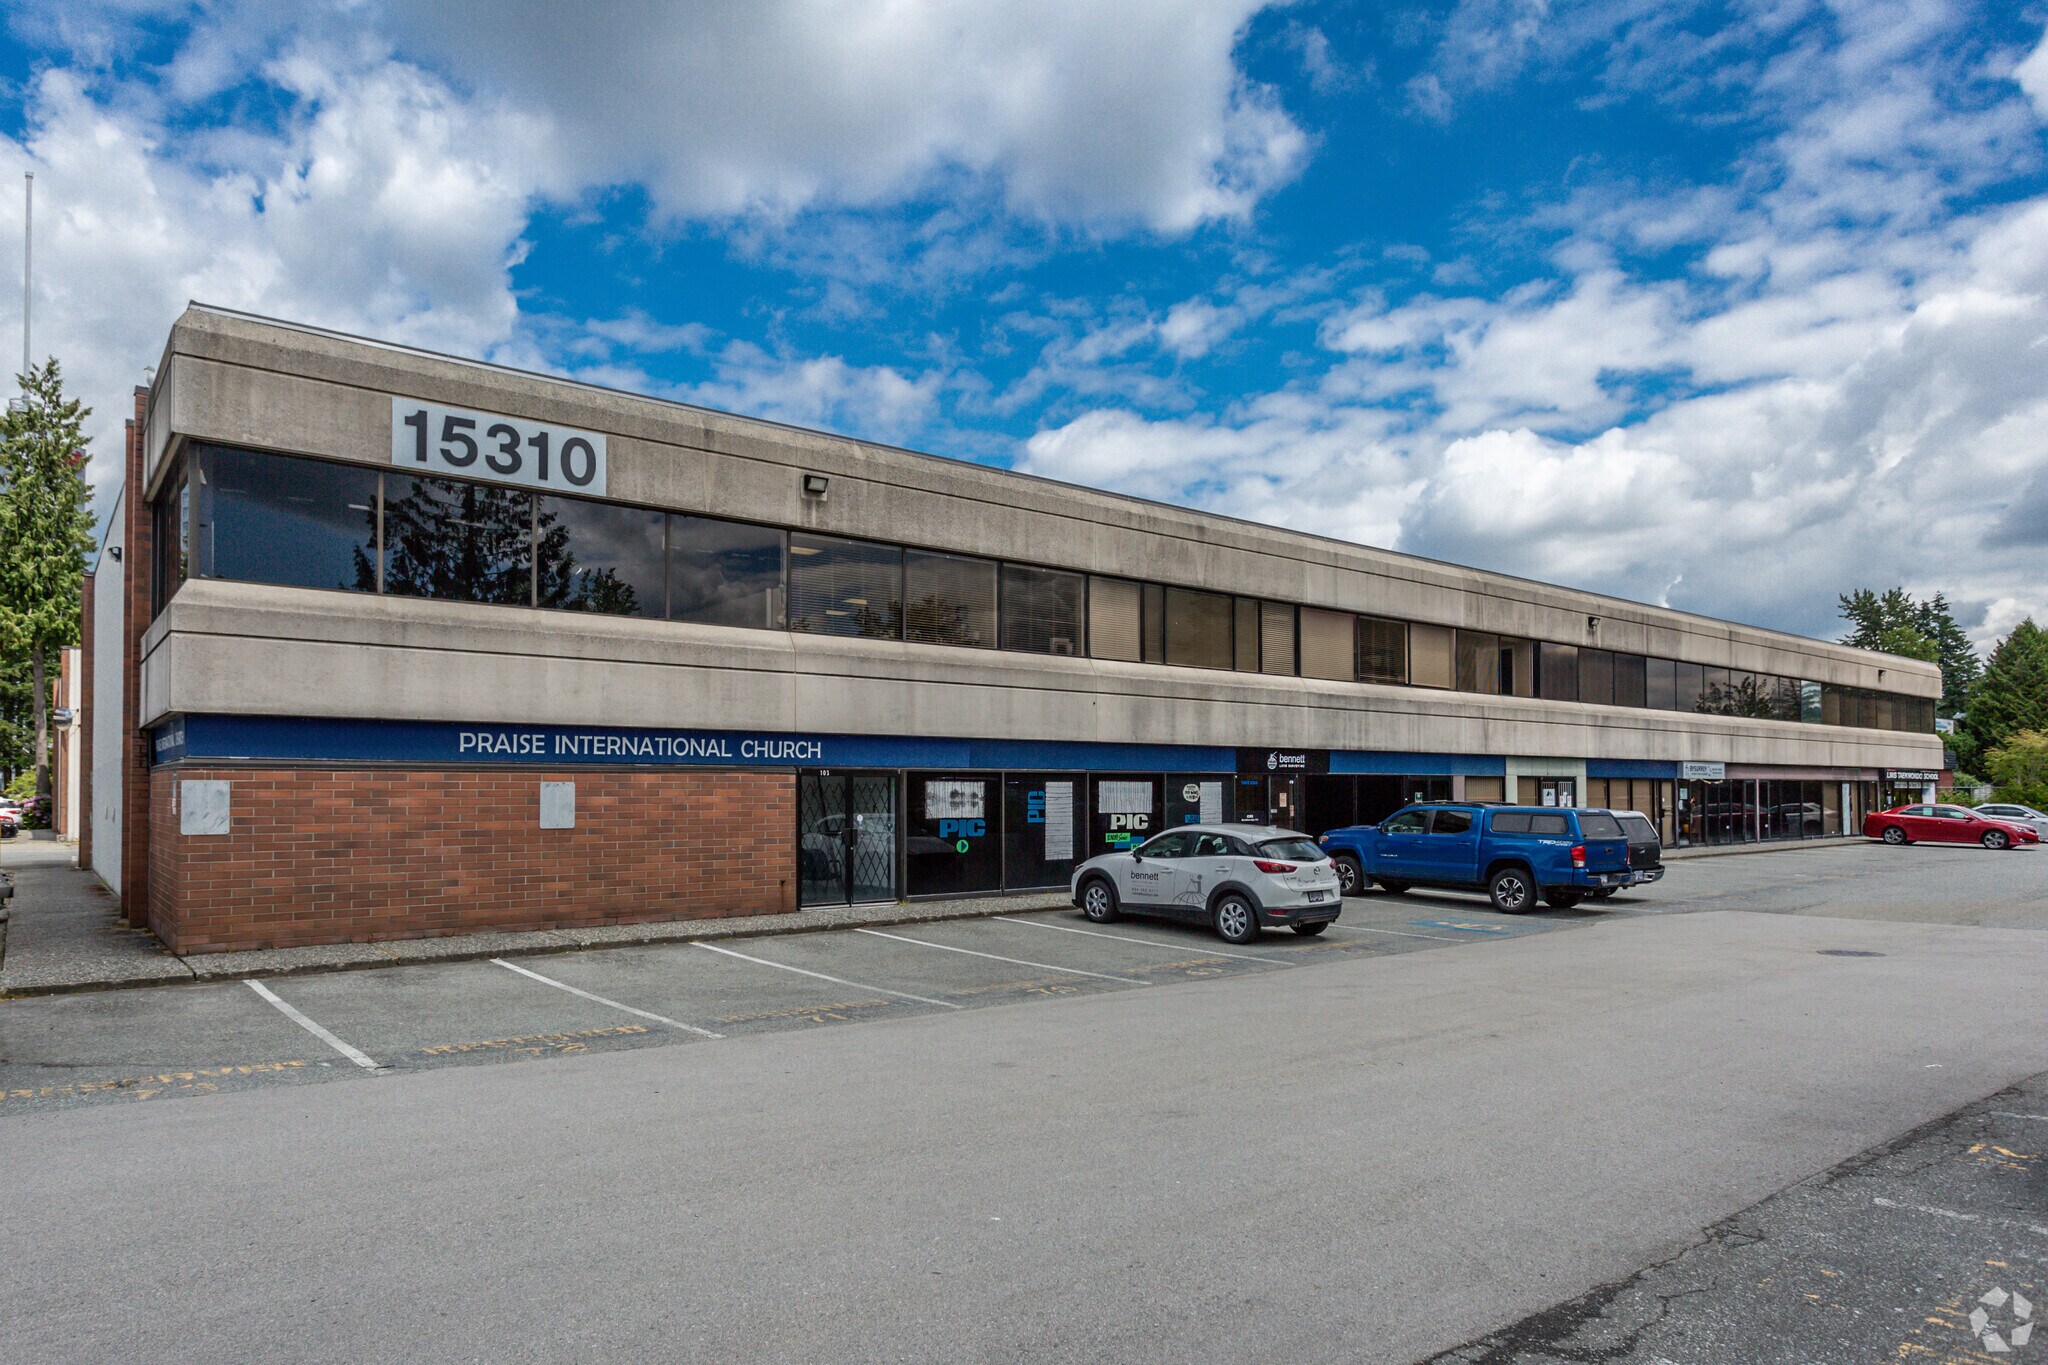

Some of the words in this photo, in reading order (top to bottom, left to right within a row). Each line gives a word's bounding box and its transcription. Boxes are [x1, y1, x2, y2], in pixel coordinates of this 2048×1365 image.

[404, 409, 596, 487] 15310
[459, 732, 546, 754] PRAISE
[555, 735, 732, 757] INTERNATIONAL
[741, 740, 822, 759] CHURCH
[1279, 753, 1305, 763] bennett
[1027, 790, 1046, 823] PIC
[939, 818, 986, 838] PIC
[1110, 813, 1149, 830] PIC
[1131, 870, 1159, 881] bennett
